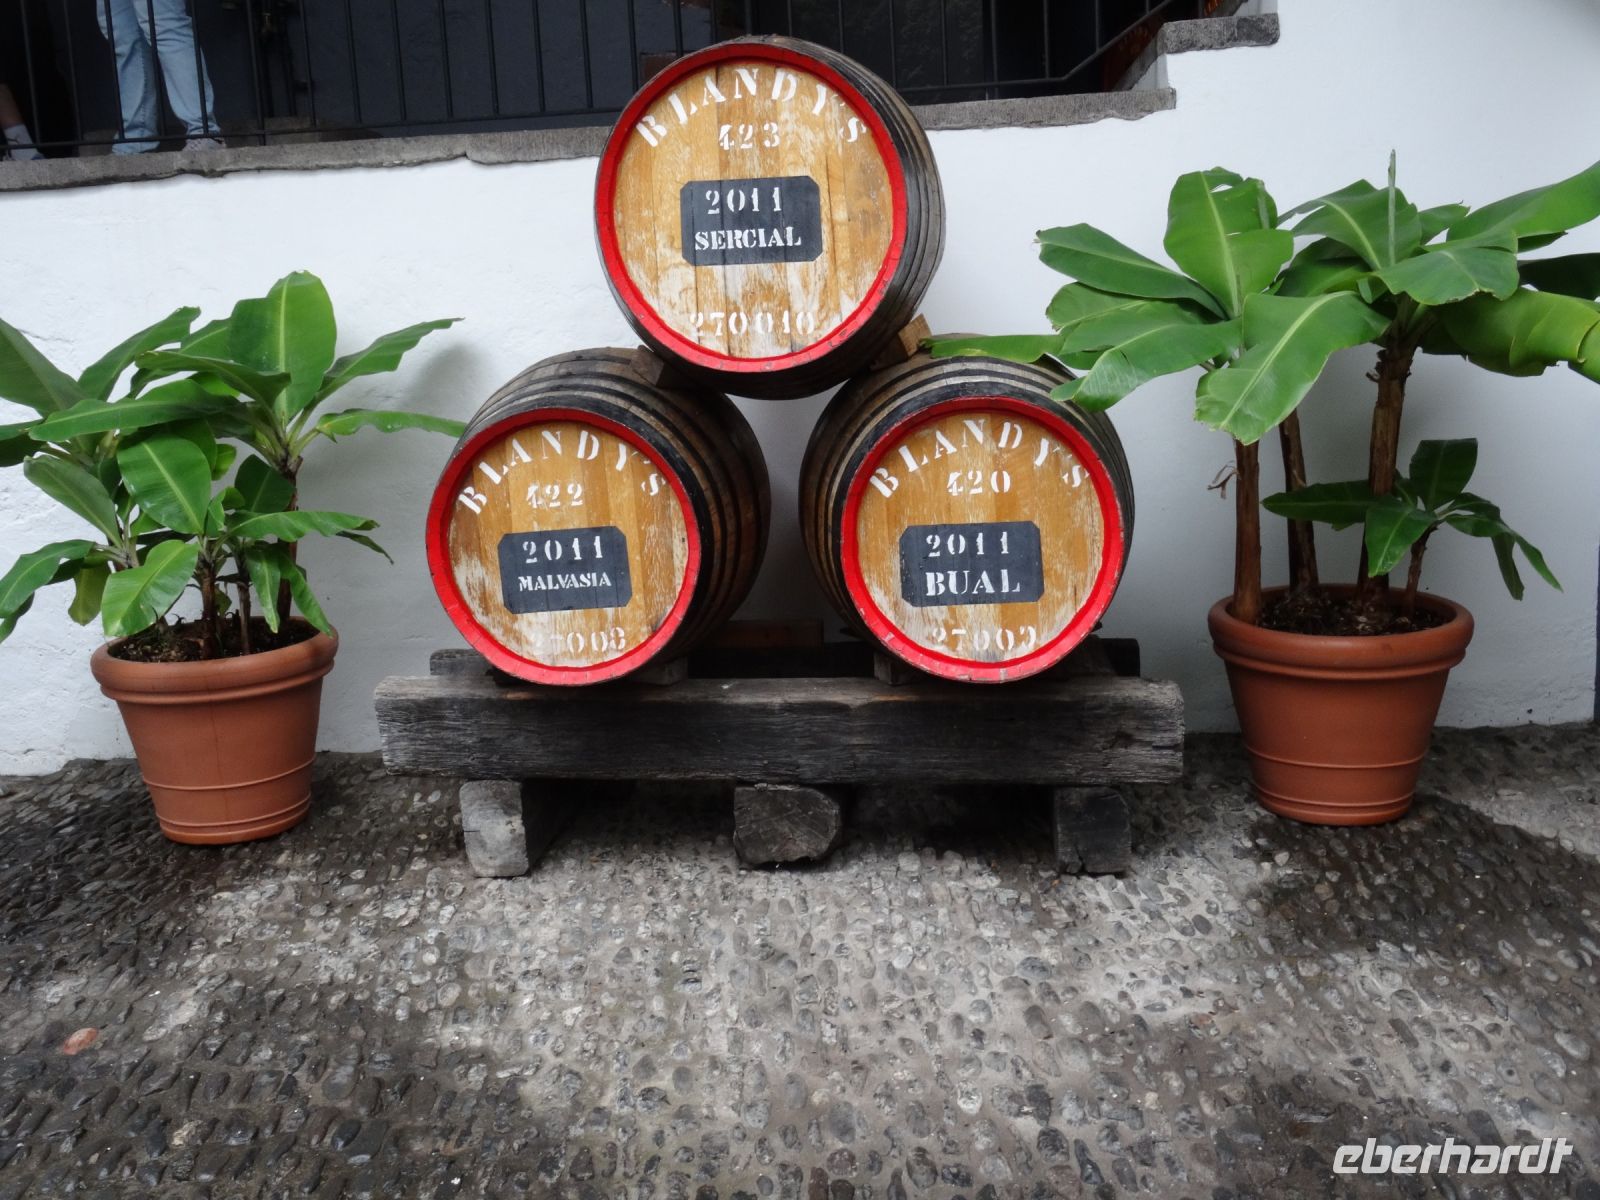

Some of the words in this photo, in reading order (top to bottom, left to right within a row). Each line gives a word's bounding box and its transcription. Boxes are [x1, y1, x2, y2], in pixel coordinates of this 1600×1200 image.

[635, 68, 867, 147] BLANDY'S
[719, 122, 781, 150] 423
[706, 187, 782, 215] 2011
[694, 226, 802, 251] SERCIAL
[690, 310, 815, 337] 270010
[459, 430, 666, 514] BLANDY'S
[869, 419, 1090, 498] BLANDY'S
[526, 482, 584, 508] 422
[946, 470, 1011, 497] 420
[522, 535, 603, 564] 2011
[926, 531, 1010, 558] 2011
[517, 571, 612, 592] MALVASIA
[925, 569, 1021, 597] BUAL
